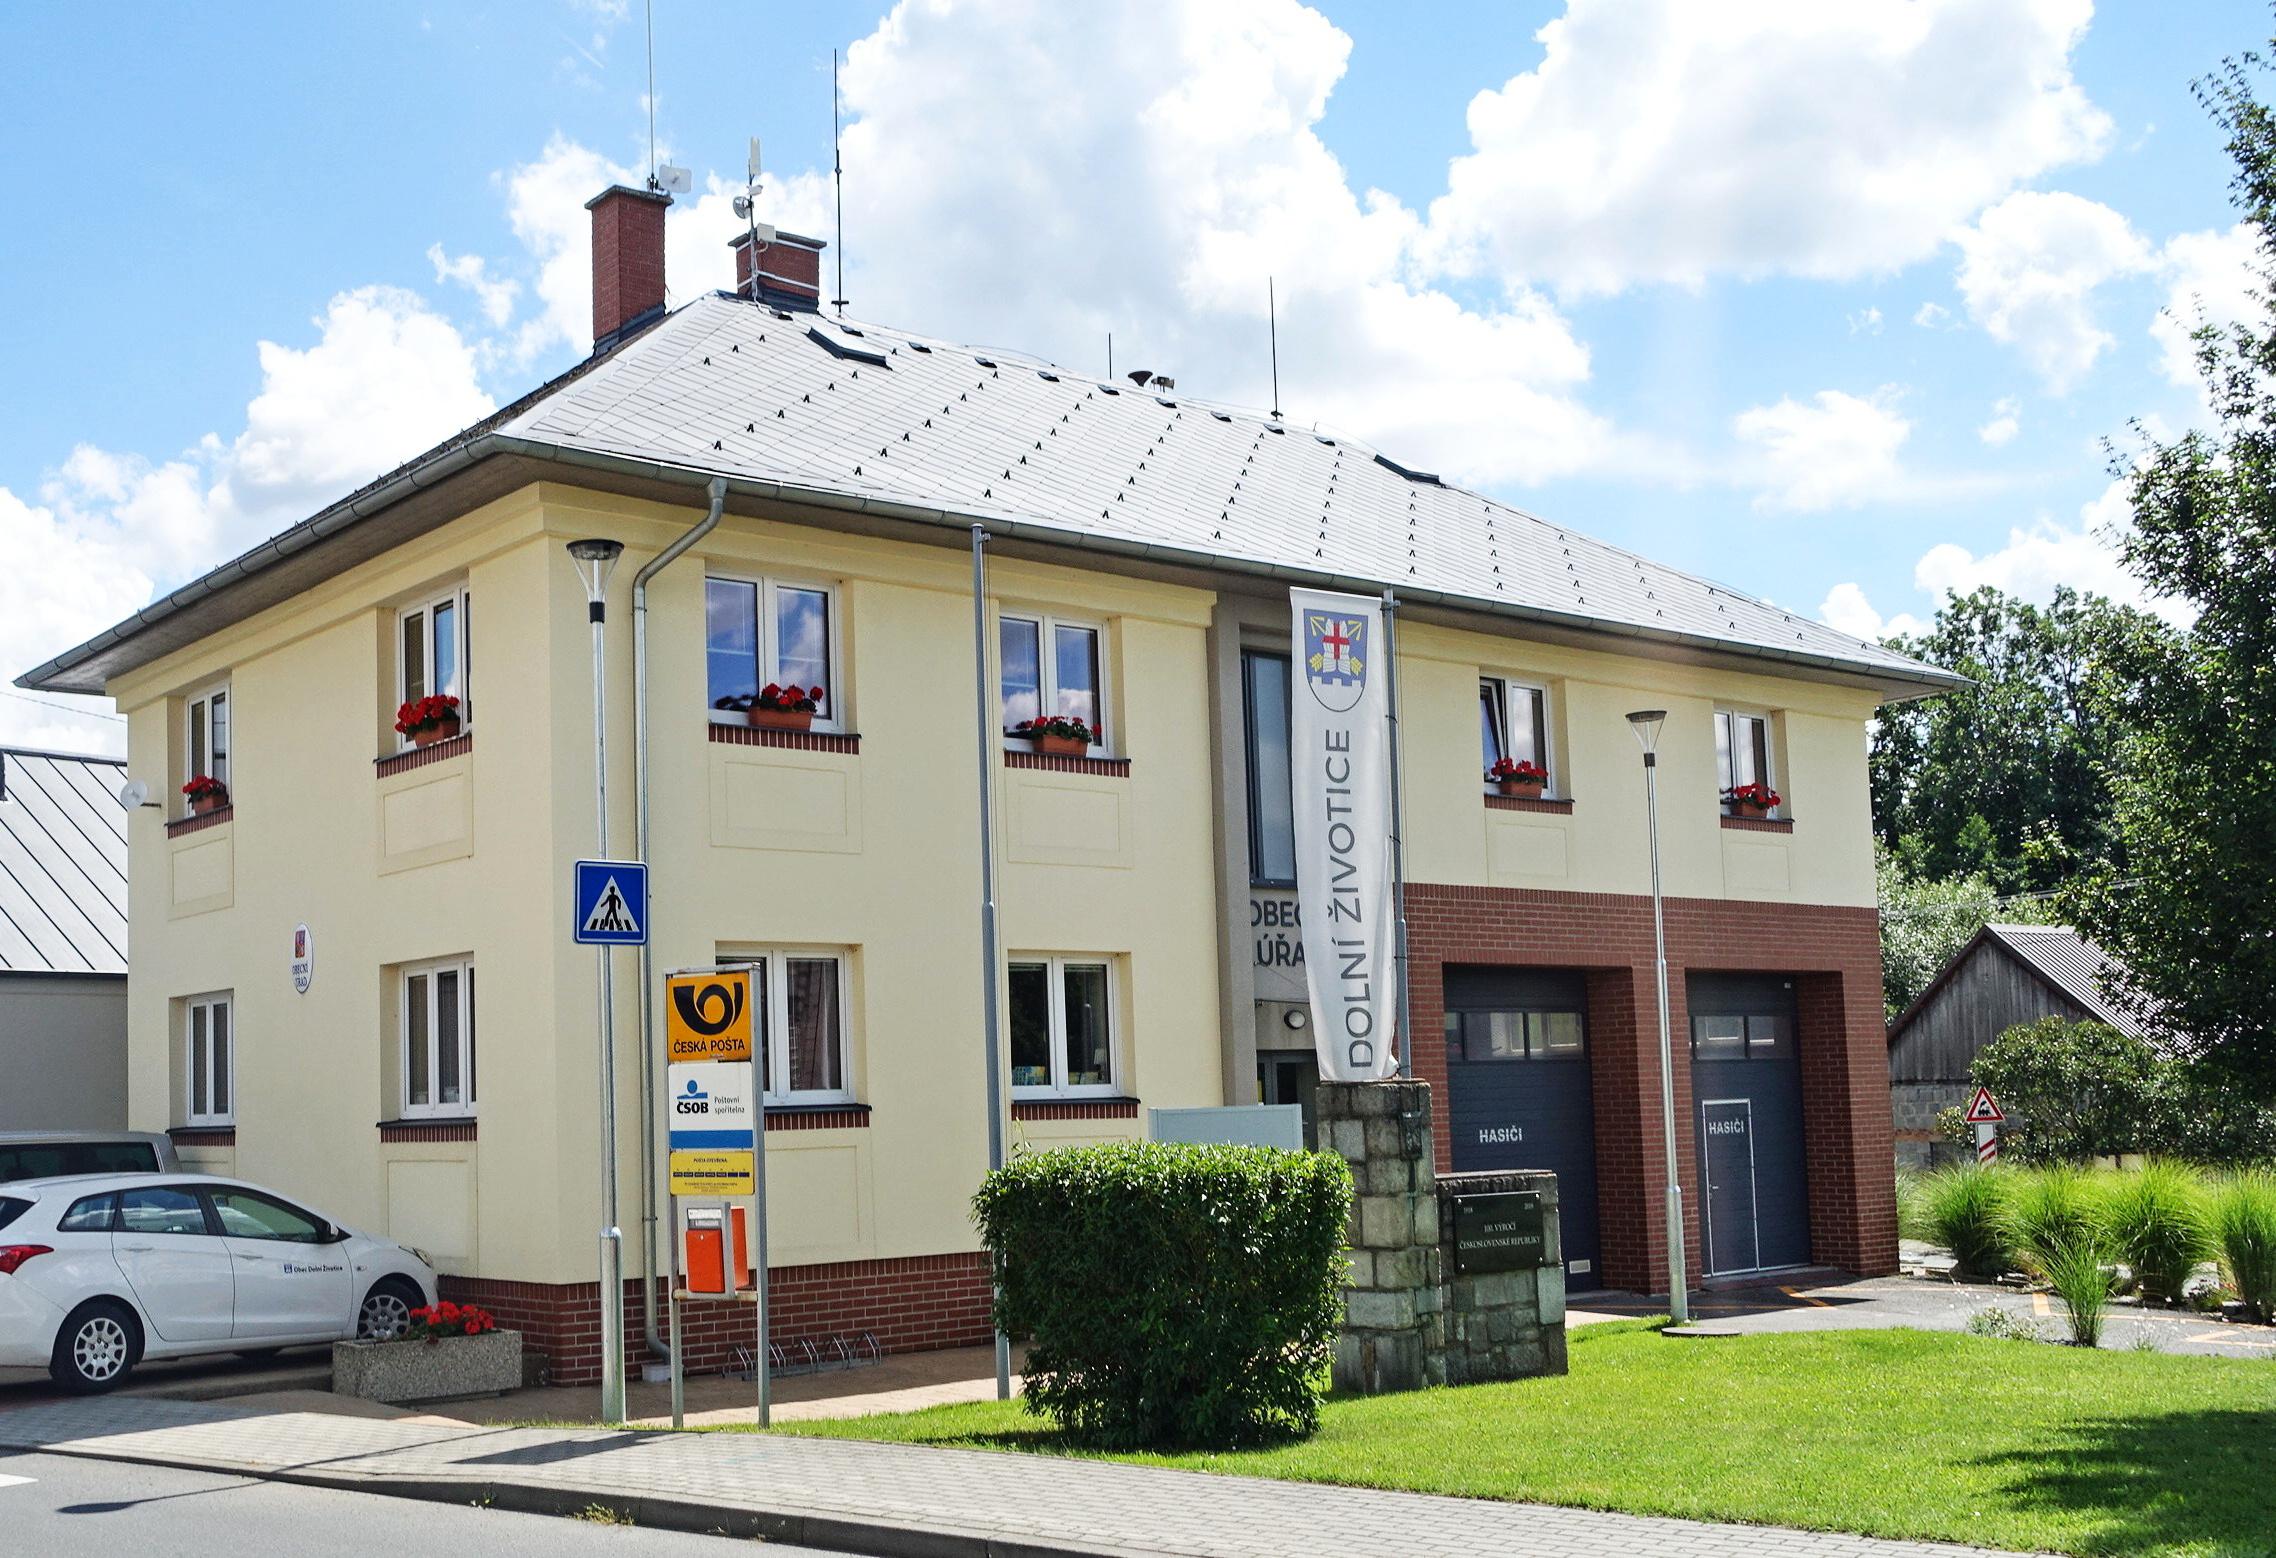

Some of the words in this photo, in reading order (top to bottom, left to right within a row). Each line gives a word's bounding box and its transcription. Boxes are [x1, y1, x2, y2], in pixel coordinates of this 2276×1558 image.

[1325, 729, 1362, 923] ŽIVOTICE
[1331, 937, 1373, 1068] DOLNÍ
[673, 1037, 707, 1054] ČESKÁ
[710, 1035, 745, 1051] POŠTA
[676, 1100, 709, 1114] ČSOB
[714, 1095, 740, 1104] Poštovní
[714, 1105, 745, 1115] spořitelna
[1479, 1124, 1523, 1143] HASIČI
[1709, 1118, 1744, 1135] HASIČI
[1511, 1235, 1540, 1246] REPUBLIKY
